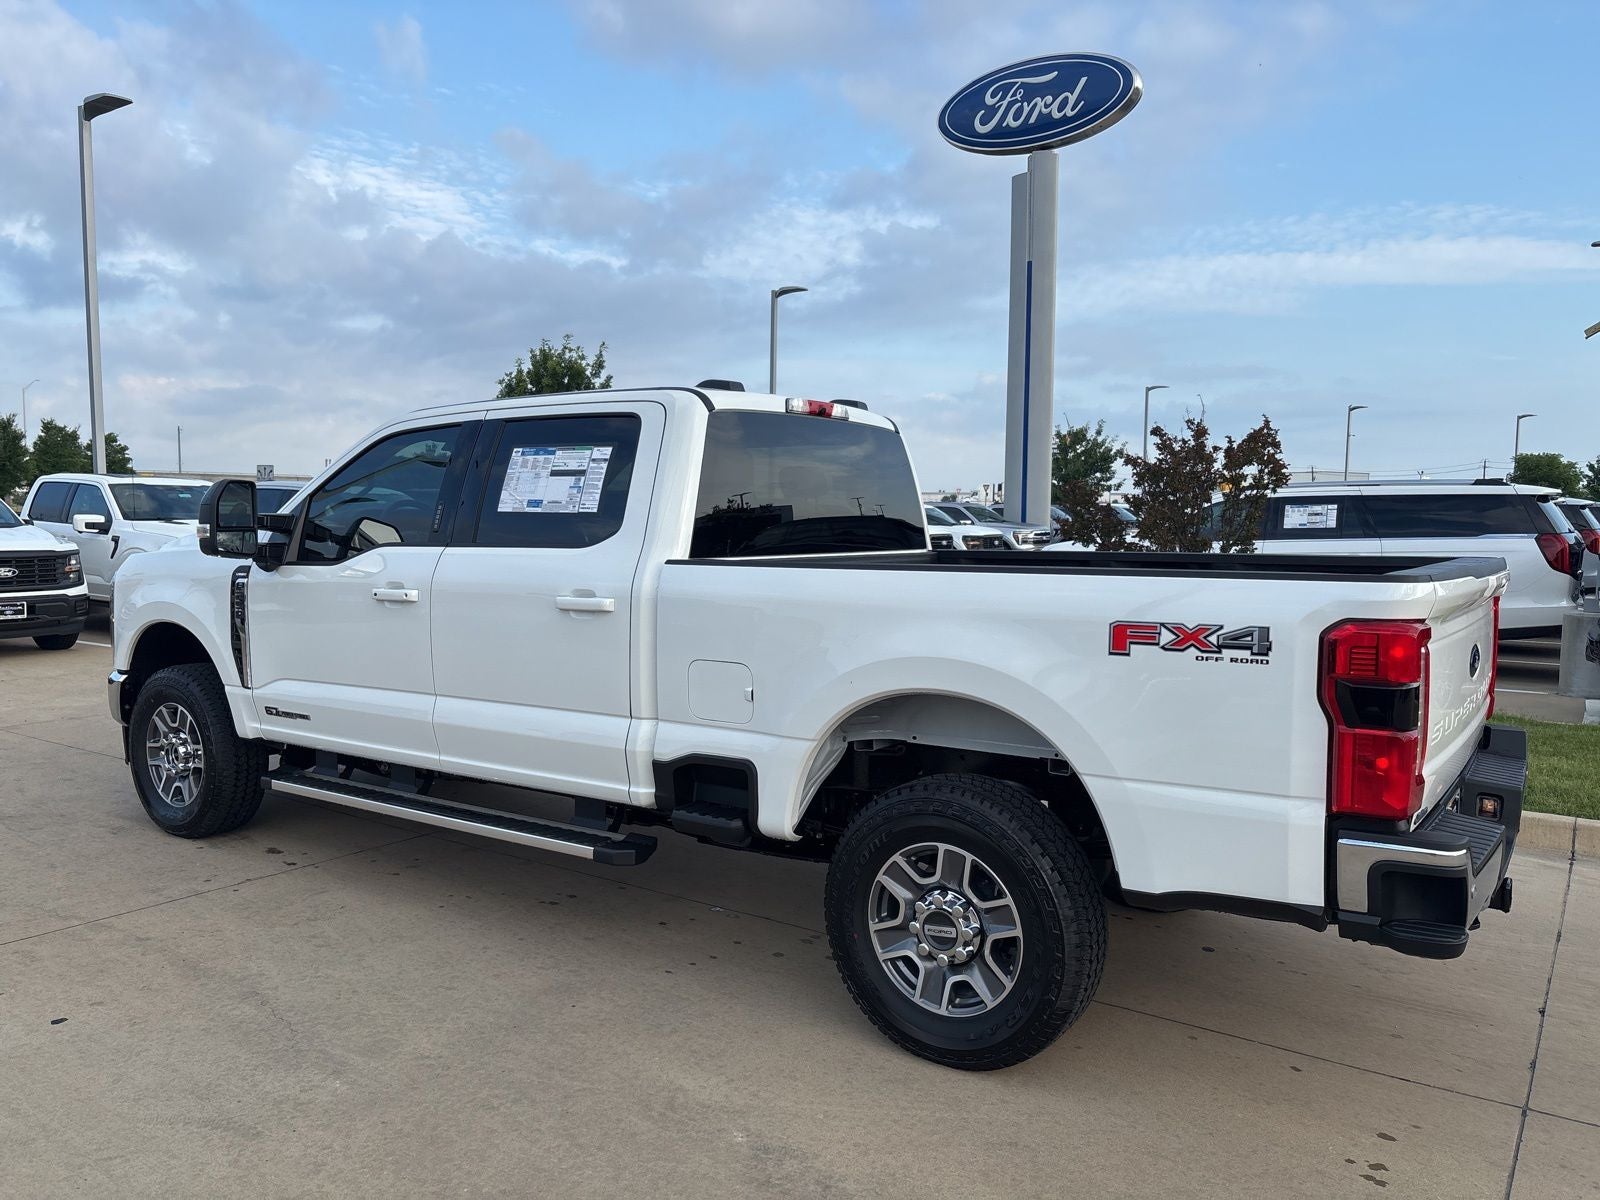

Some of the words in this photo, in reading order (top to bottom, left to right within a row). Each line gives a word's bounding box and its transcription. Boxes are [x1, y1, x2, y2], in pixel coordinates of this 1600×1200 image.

[974, 71, 1088, 134] Ford
[1108, 620, 1272, 657] FX4
[1229, 657, 1270, 665] ROAD
